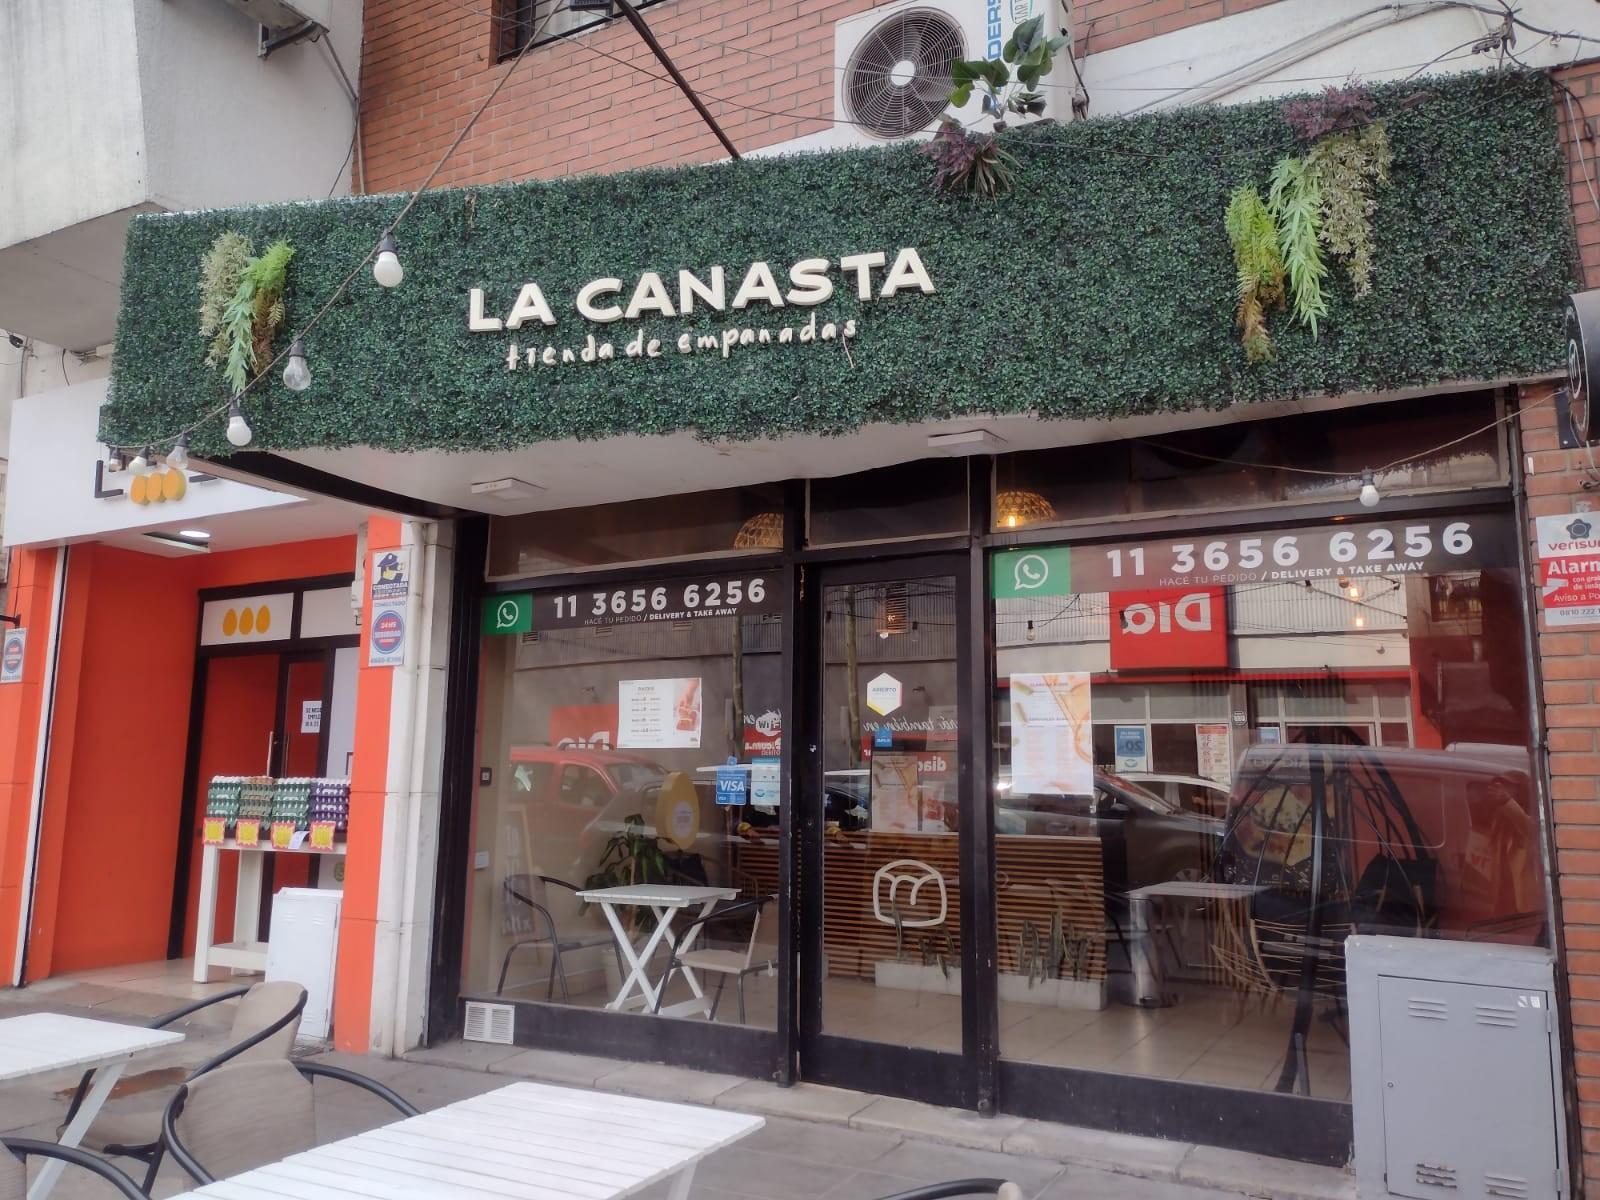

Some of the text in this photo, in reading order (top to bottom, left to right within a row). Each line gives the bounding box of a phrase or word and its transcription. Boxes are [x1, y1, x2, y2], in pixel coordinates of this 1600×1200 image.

[468, 247, 937, 332] LA CANASTA
[506, 312, 856, 371] tienda de empanadas
[1106, 522, 1473, 577] 11 3656 6256
[1548, 538, 1600, 552] verisu
[1193, 576, 1208, 584] TU
[1212, 573, 1257, 584] PEDIDO
[1271, 567, 1332, 579] DELIVERY
[1348, 564, 1382, 575] TAKE
[1386, 561, 1424, 572] AWAY
[554, 578, 765, 619] 11 3656 6256
[649, 611, 684, 620] DELIVERY
[693, 609, 713, 617] TAKE
[715, 607, 737, 615] AWAY
[720, 780, 745, 792] VISA
